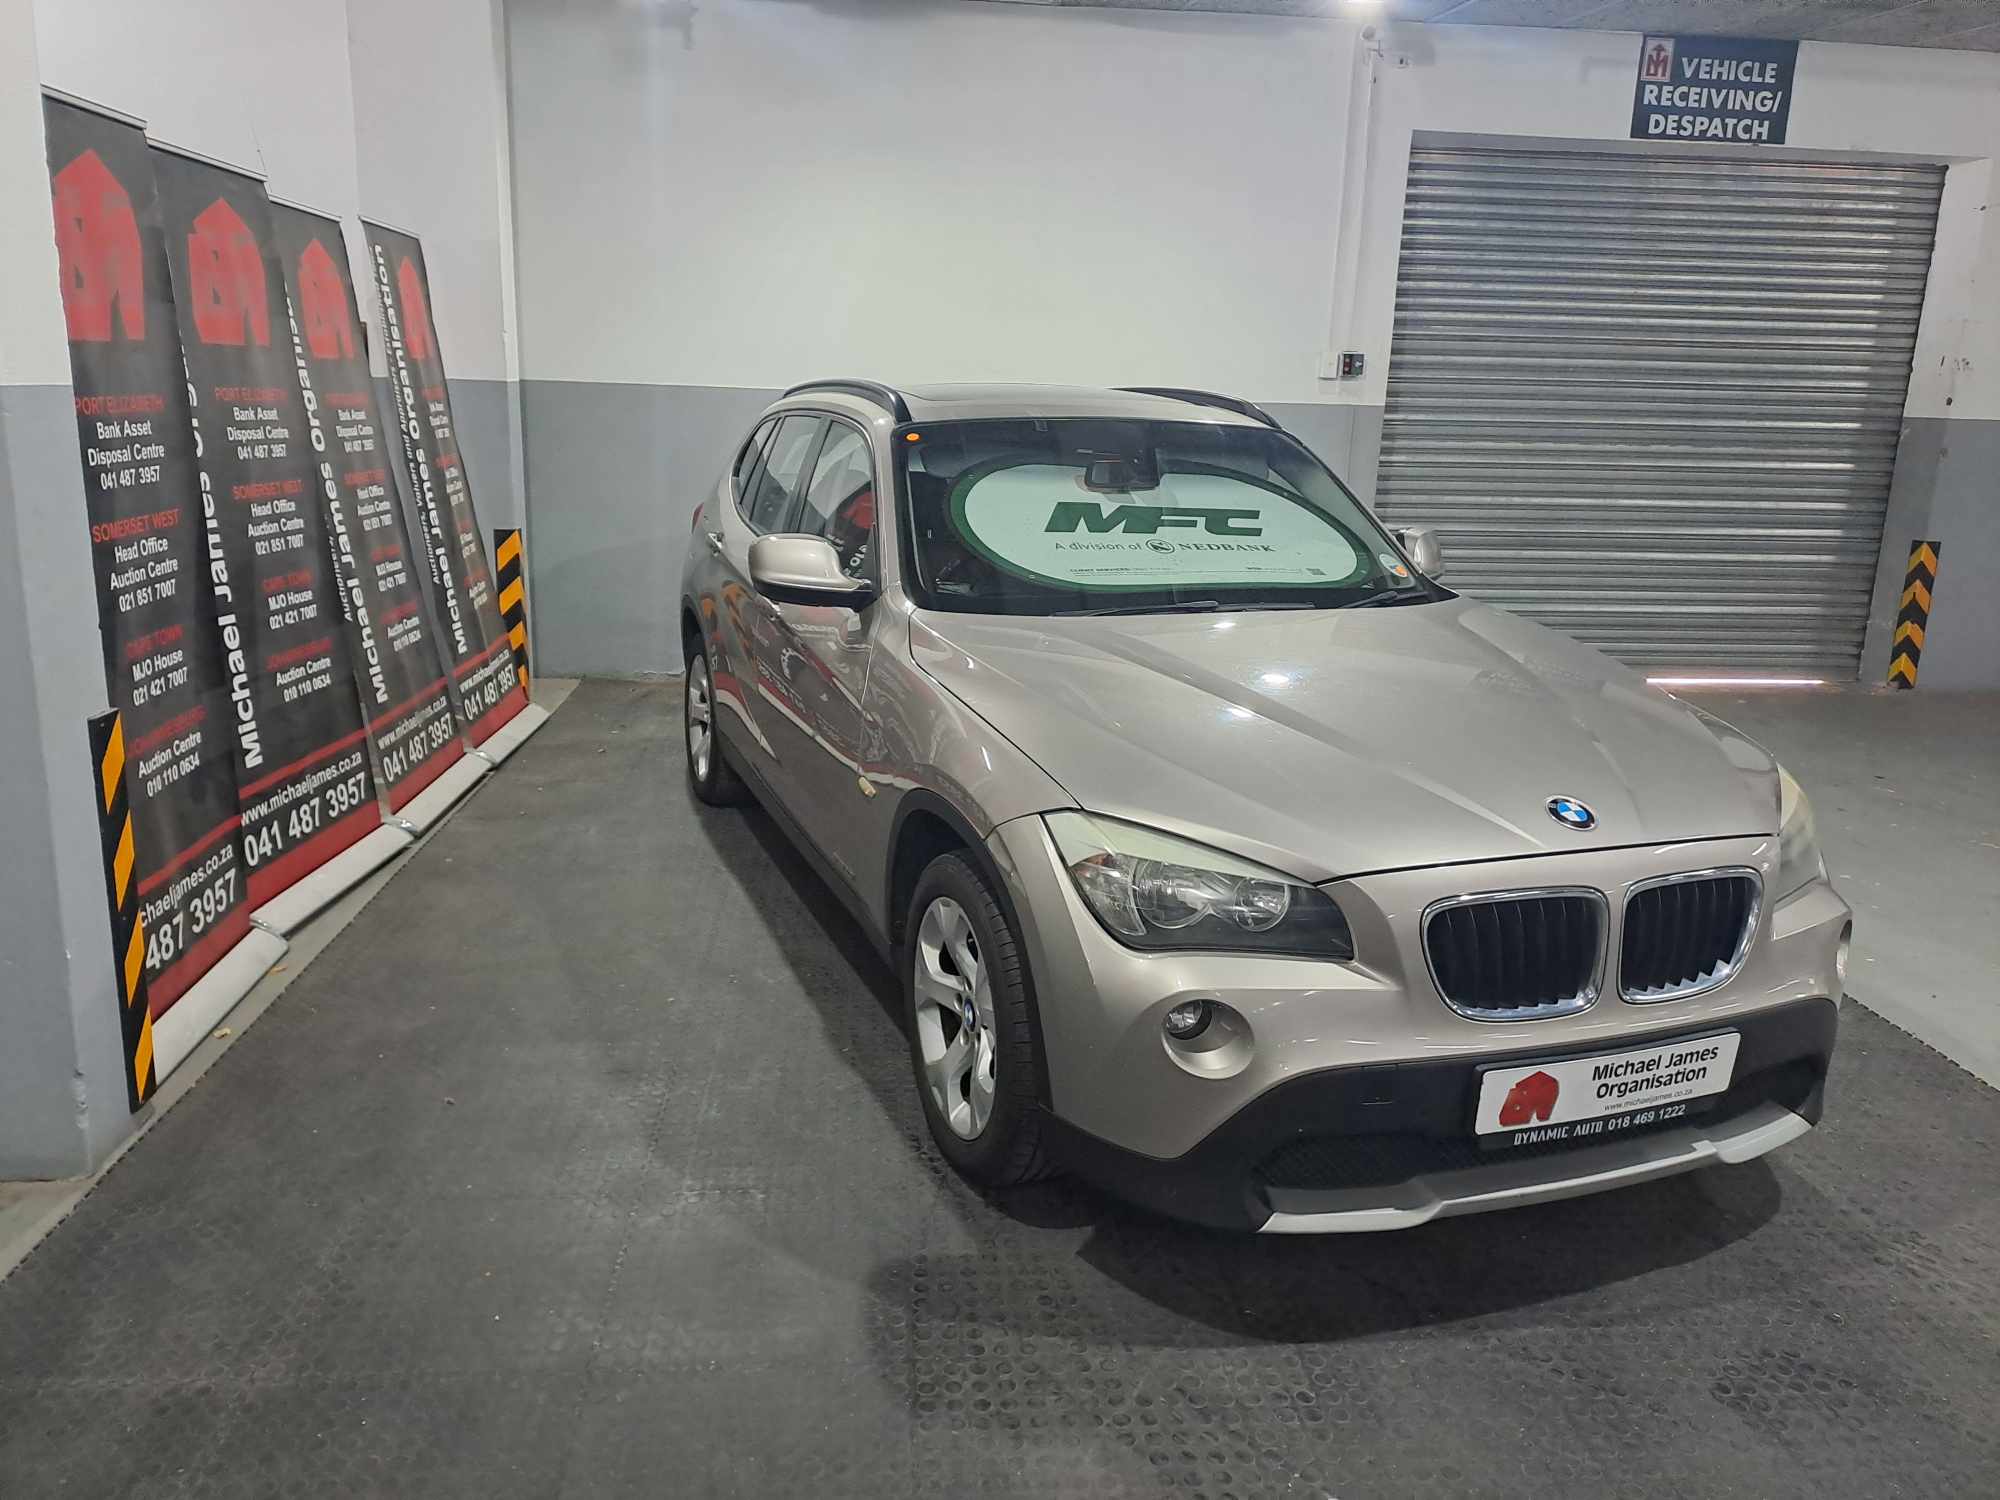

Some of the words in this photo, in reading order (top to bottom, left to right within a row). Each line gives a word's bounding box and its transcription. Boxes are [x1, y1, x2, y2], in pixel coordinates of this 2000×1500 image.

[1682, 57, 1778, 83] VEHICLE
[1643, 84, 1782, 113] RECEIVING/
[1648, 114, 1769, 140] DESPATCH
[374, 244, 420, 440] Organisation
[96, 421, 122, 440] Bank
[124, 420, 153, 437] Asset
[233, 406, 256, 421] Bank
[226, 426, 264, 443] Disposal
[87, 445, 132, 468] Disposal
[133, 443, 165, 460] Centre
[237, 445, 253, 461] 041
[100, 472, 118, 490] 041
[119, 468, 135, 487] 487
[139, 465, 160, 484] 3957
[416, 448, 443, 539] James
[251, 502, 272, 517] Head
[273, 499, 296, 514] Office
[320, 462, 355, 568] James
[1045, 502, 1263, 536] MFC
[92, 516, 149, 543] SOMERSET
[151, 508, 180, 529] WEST
[248, 521, 280, 537] Auction
[280, 517, 304, 532] Centre
[114, 541, 138, 563] Head
[140, 537, 169, 556] Office
[255, 541, 270, 556] 021
[271, 538, 286, 553] 851
[1055, 542, 1066, 550] A
[1069, 541, 1124, 551] division
[1130, 541, 1142, 550] of
[1178, 542, 1277, 552] NEDBANK
[110, 567, 147, 590] Auction
[148, 558, 178, 578] Centre
[119, 593, 135, 612] 021
[136, 585, 153, 606] 851
[155, 578, 176, 600] 7007
[287, 589, 313, 605] House
[435, 547, 468, 655] Michael
[269, 615, 284, 630] 021
[284, 609, 299, 624] 421
[346, 578, 389, 704] Michael
[132, 660, 152, 682] MJO
[154, 649, 183, 672] House
[276, 664, 306, 687] Auction
[133, 686, 149, 706] 021
[150, 676, 165, 698] 421
[167, 667, 188, 689] 7007
[218, 614, 263, 769] Michael
[464, 690, 483, 721] 041
[484, 677, 500, 705] 487
[138, 750, 172, 779] Auction
[173, 731, 202, 755] Centre
[383, 746, 408, 782] 041
[409, 730, 428, 763] 487
[428, 712, 453, 749] 3957
[147, 775, 162, 798] 010
[163, 765, 178, 786] 110
[180, 752, 201, 777] 0634
[240, 751, 362, 827] www.michaeljames.co.za
[244, 820, 283, 867] 041
[289, 797, 320, 839] 487
[325, 771, 366, 818] 3957
[140, 844, 234, 928] chaeljames.co.za
[146, 912, 183, 969] 487
[190, 867, 236, 934] 3957
[1592, 1055, 1662, 1081] Michael
[1665, 1046, 1719, 1069] James
[1596, 1066, 1707, 1098] Organisation
[1604, 1089, 1693, 1111] www.michaeljames.co.za
[1513, 1126, 1569, 1145] DYNAMIC
[1573, 1121, 1603, 1137] AUTO
[1608, 1115, 1631, 1131] 018
[1632, 1111, 1655, 1126] 469
[1658, 1104, 1686, 1120] 1222
